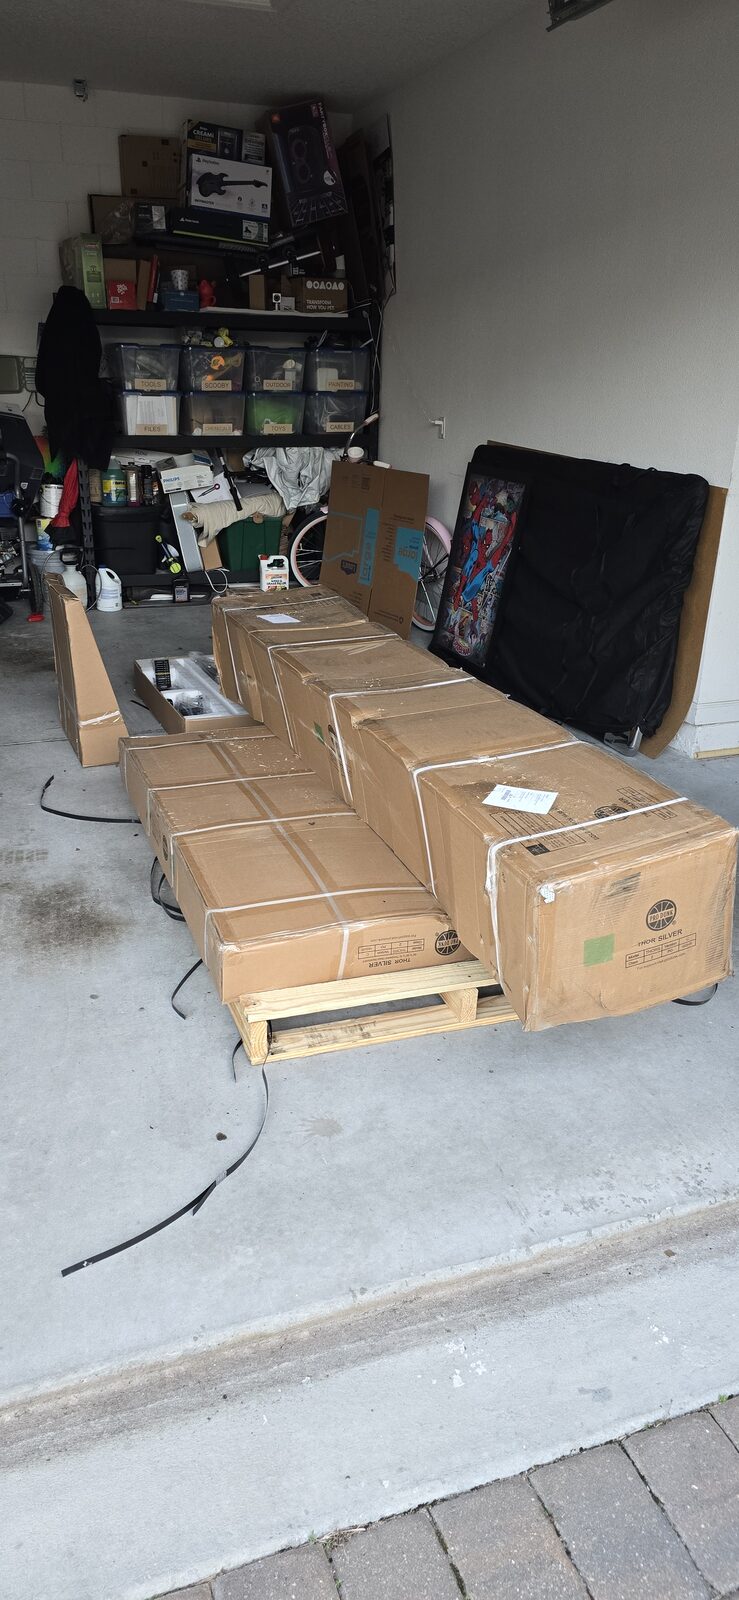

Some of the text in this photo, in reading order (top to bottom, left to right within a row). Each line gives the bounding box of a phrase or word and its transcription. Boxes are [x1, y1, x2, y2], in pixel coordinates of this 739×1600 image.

[141, 380, 162, 388] TOOLS
[649, 909, 674, 923] PRO DUNK
[638, 929, 683, 947] THOR SILVER
[368, 960, 392, 968] SILVER
